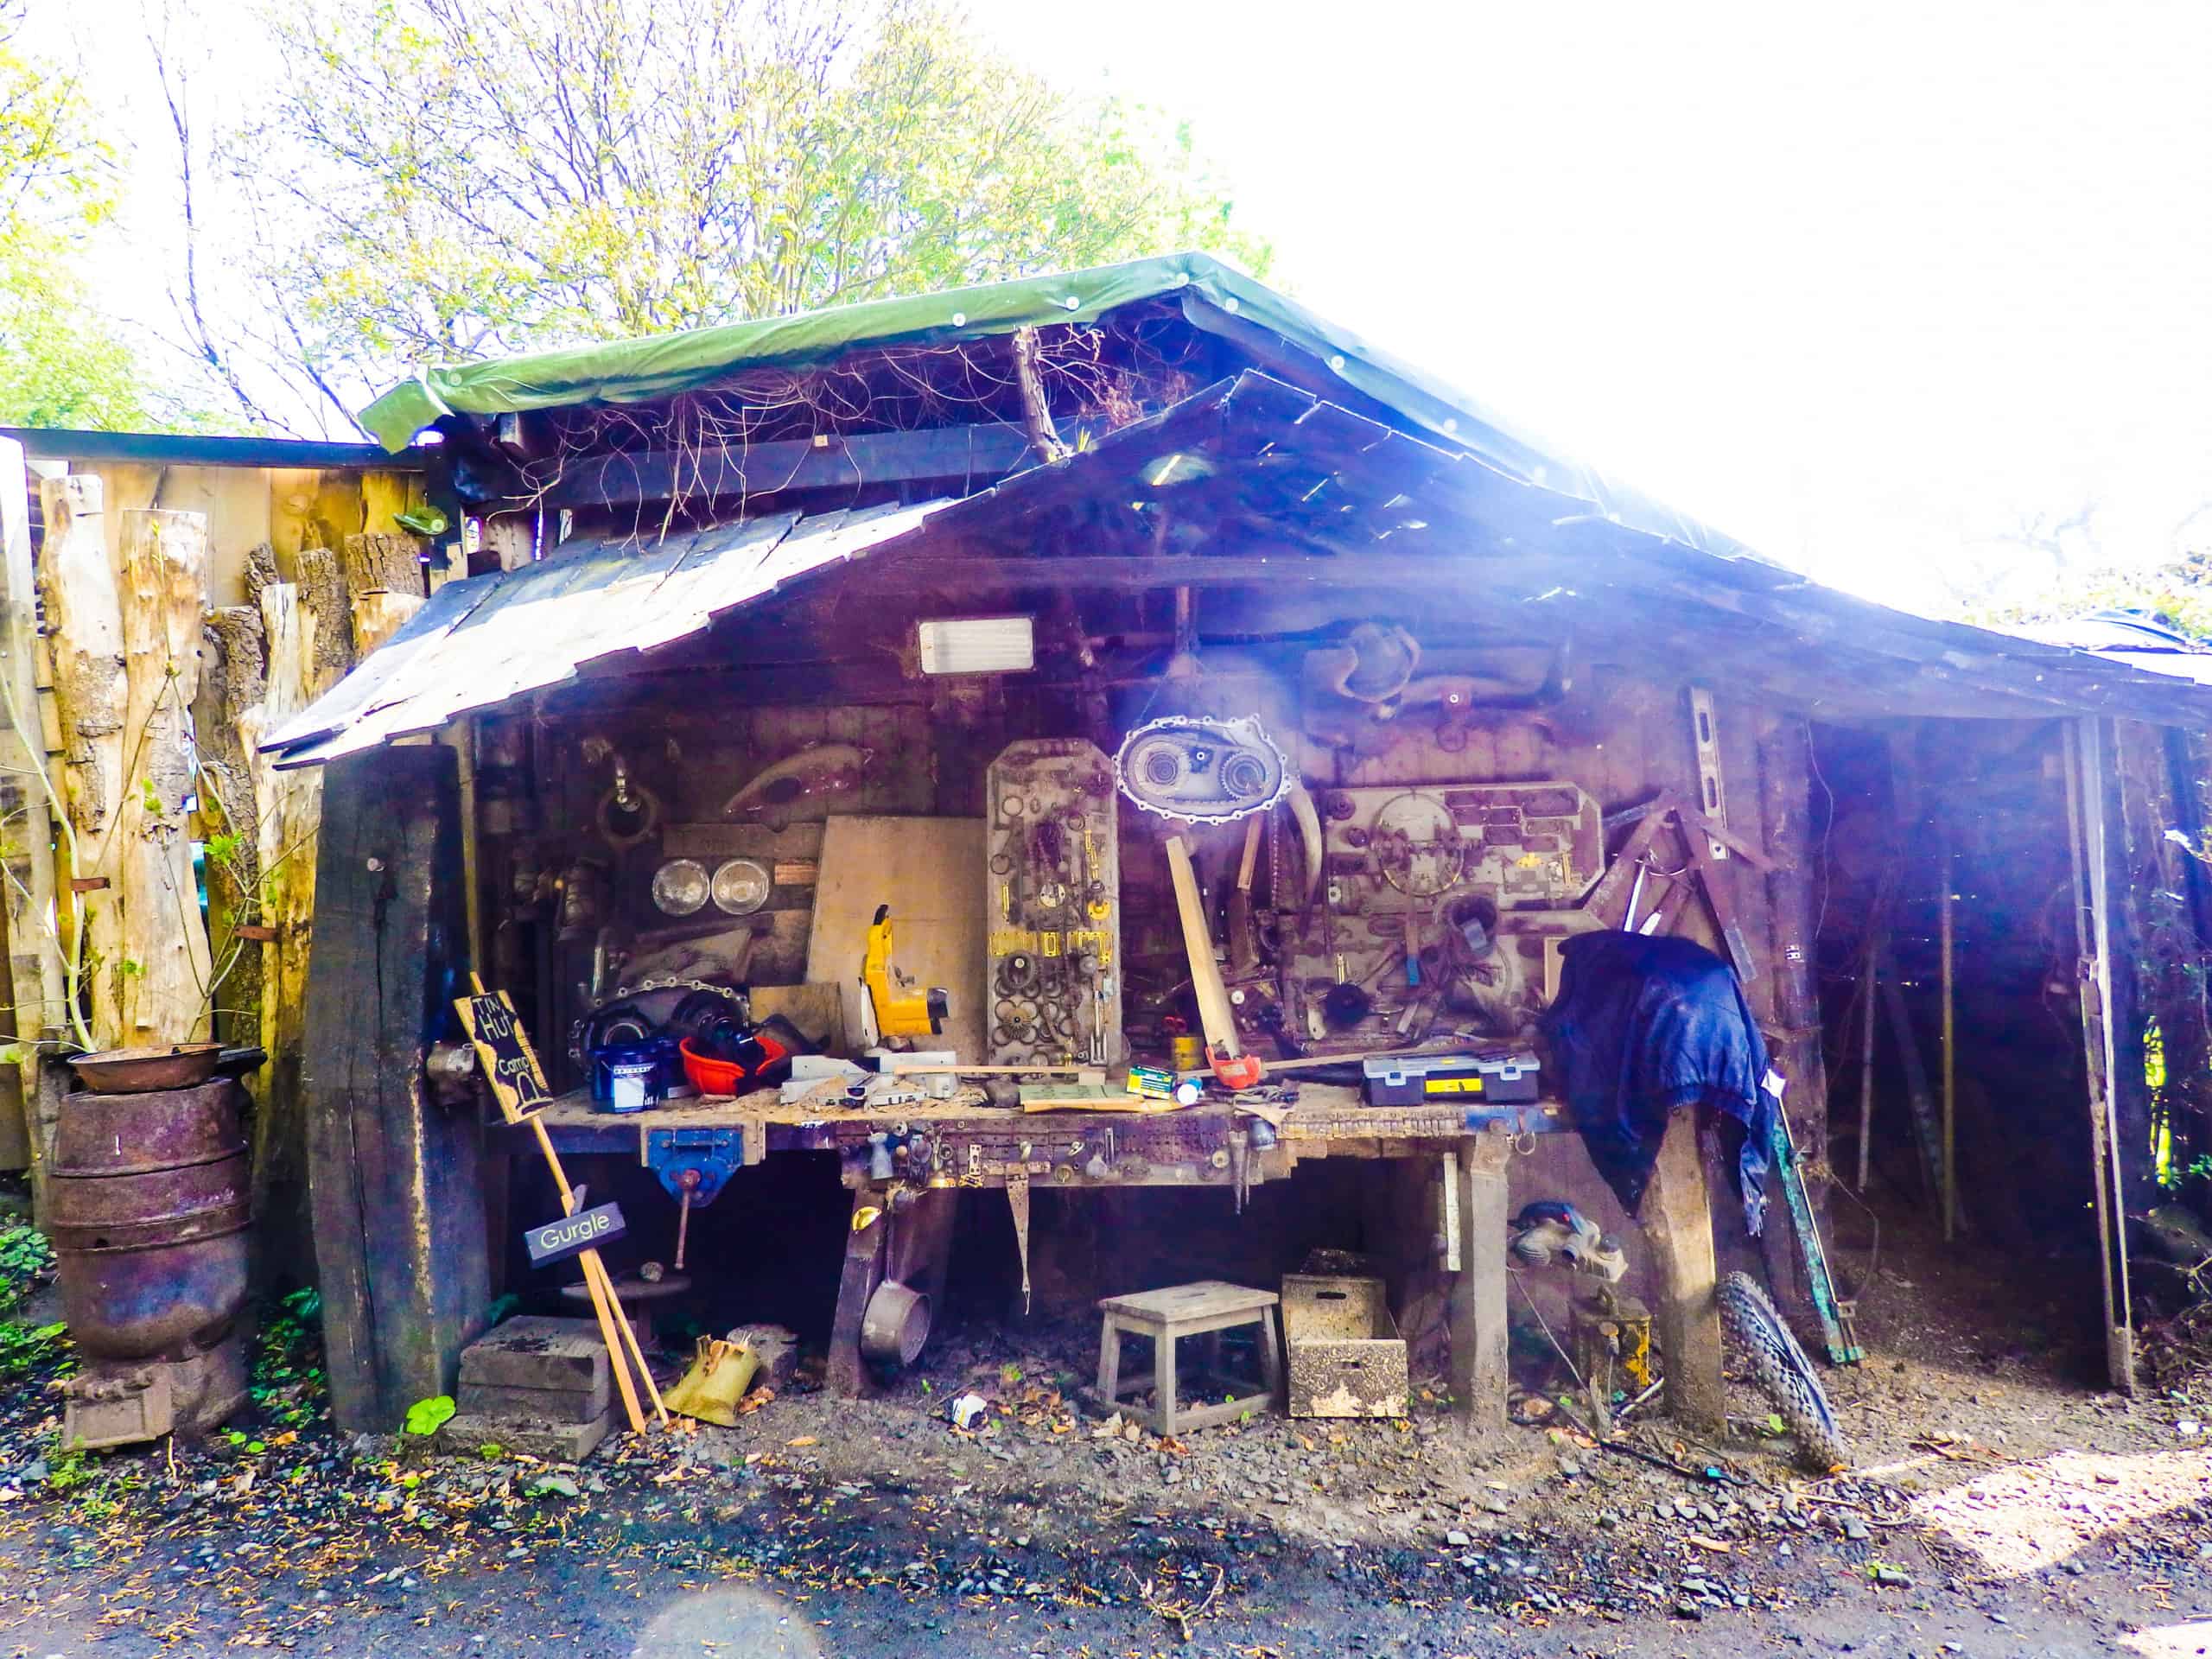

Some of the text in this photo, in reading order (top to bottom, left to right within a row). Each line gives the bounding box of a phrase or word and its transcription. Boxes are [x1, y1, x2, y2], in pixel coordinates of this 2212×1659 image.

[472, 996, 500, 1014] TIN
[499, 1057, 530, 1076] Camp
[540, 1213, 610, 1249] Gurgle
